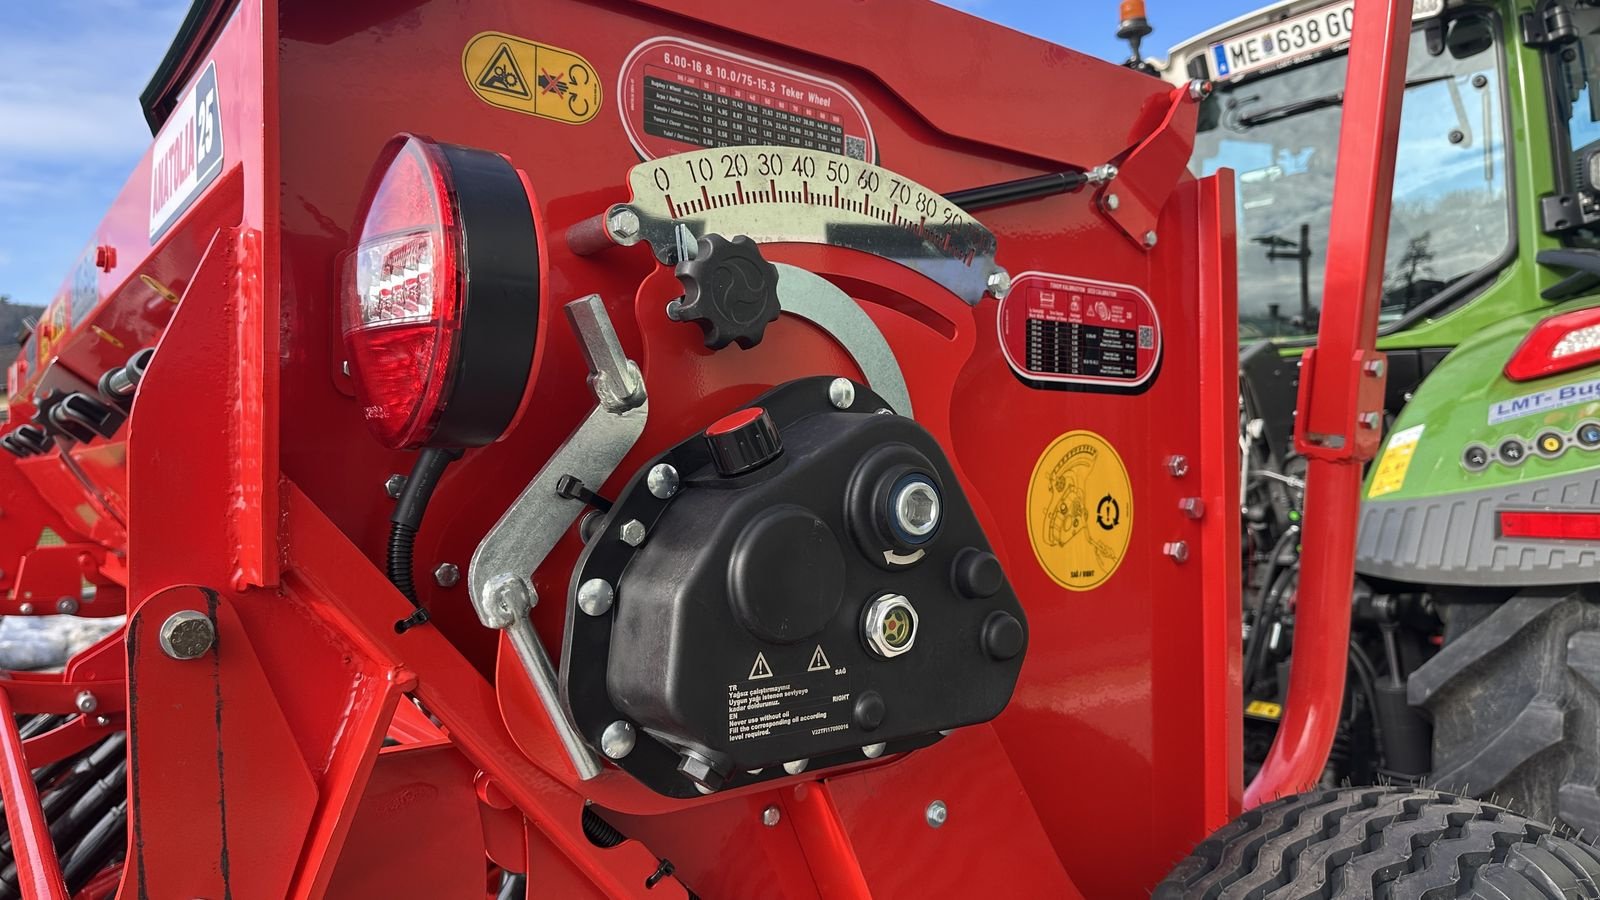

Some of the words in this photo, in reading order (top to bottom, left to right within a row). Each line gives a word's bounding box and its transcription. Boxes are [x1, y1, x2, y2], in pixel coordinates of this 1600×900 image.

[1229, 38, 1261, 69] ME
[1275, 18, 1322, 54] 638
[663, 52, 702, 73] 6.00-16
[705, 63, 713, 76] &
[716, 66, 776, 93] 10.0/75-15.3
[781, 84, 804, 100] Teker
[808, 91, 831, 108] Wheel
[152, 114, 195, 219] ANATOLIA
[198, 88, 214, 164] 25
[654, 166, 670, 192] 0
[686, 158, 714, 184] 10
[720, 153, 748, 178] 20
[757, 153, 783, 176] 30
[791, 155, 816, 178] 40
[826, 160, 849, 184] 50
[857, 169, 880, 193] 60
[889, 179, 912, 205] 70
[916, 192, 938, 218] 80
[944, 208, 962, 233] 90
[1497, 392, 1552, 415] LMT-
[728, 698, 748, 707] Uygun
[784, 688, 808, 698] seviyeye
[729, 684, 738, 692] TR
[832, 693, 850, 702] RIGHT
[729, 705, 746, 713] kadar
[729, 719, 747, 727] Never
[760, 712, 781, 722] without
[729, 727, 738, 735] Fill
[751, 717, 791, 730] corresponding
[800, 712, 827, 722] according
[730, 734, 744, 742] level
[745, 730, 770, 740] required.
